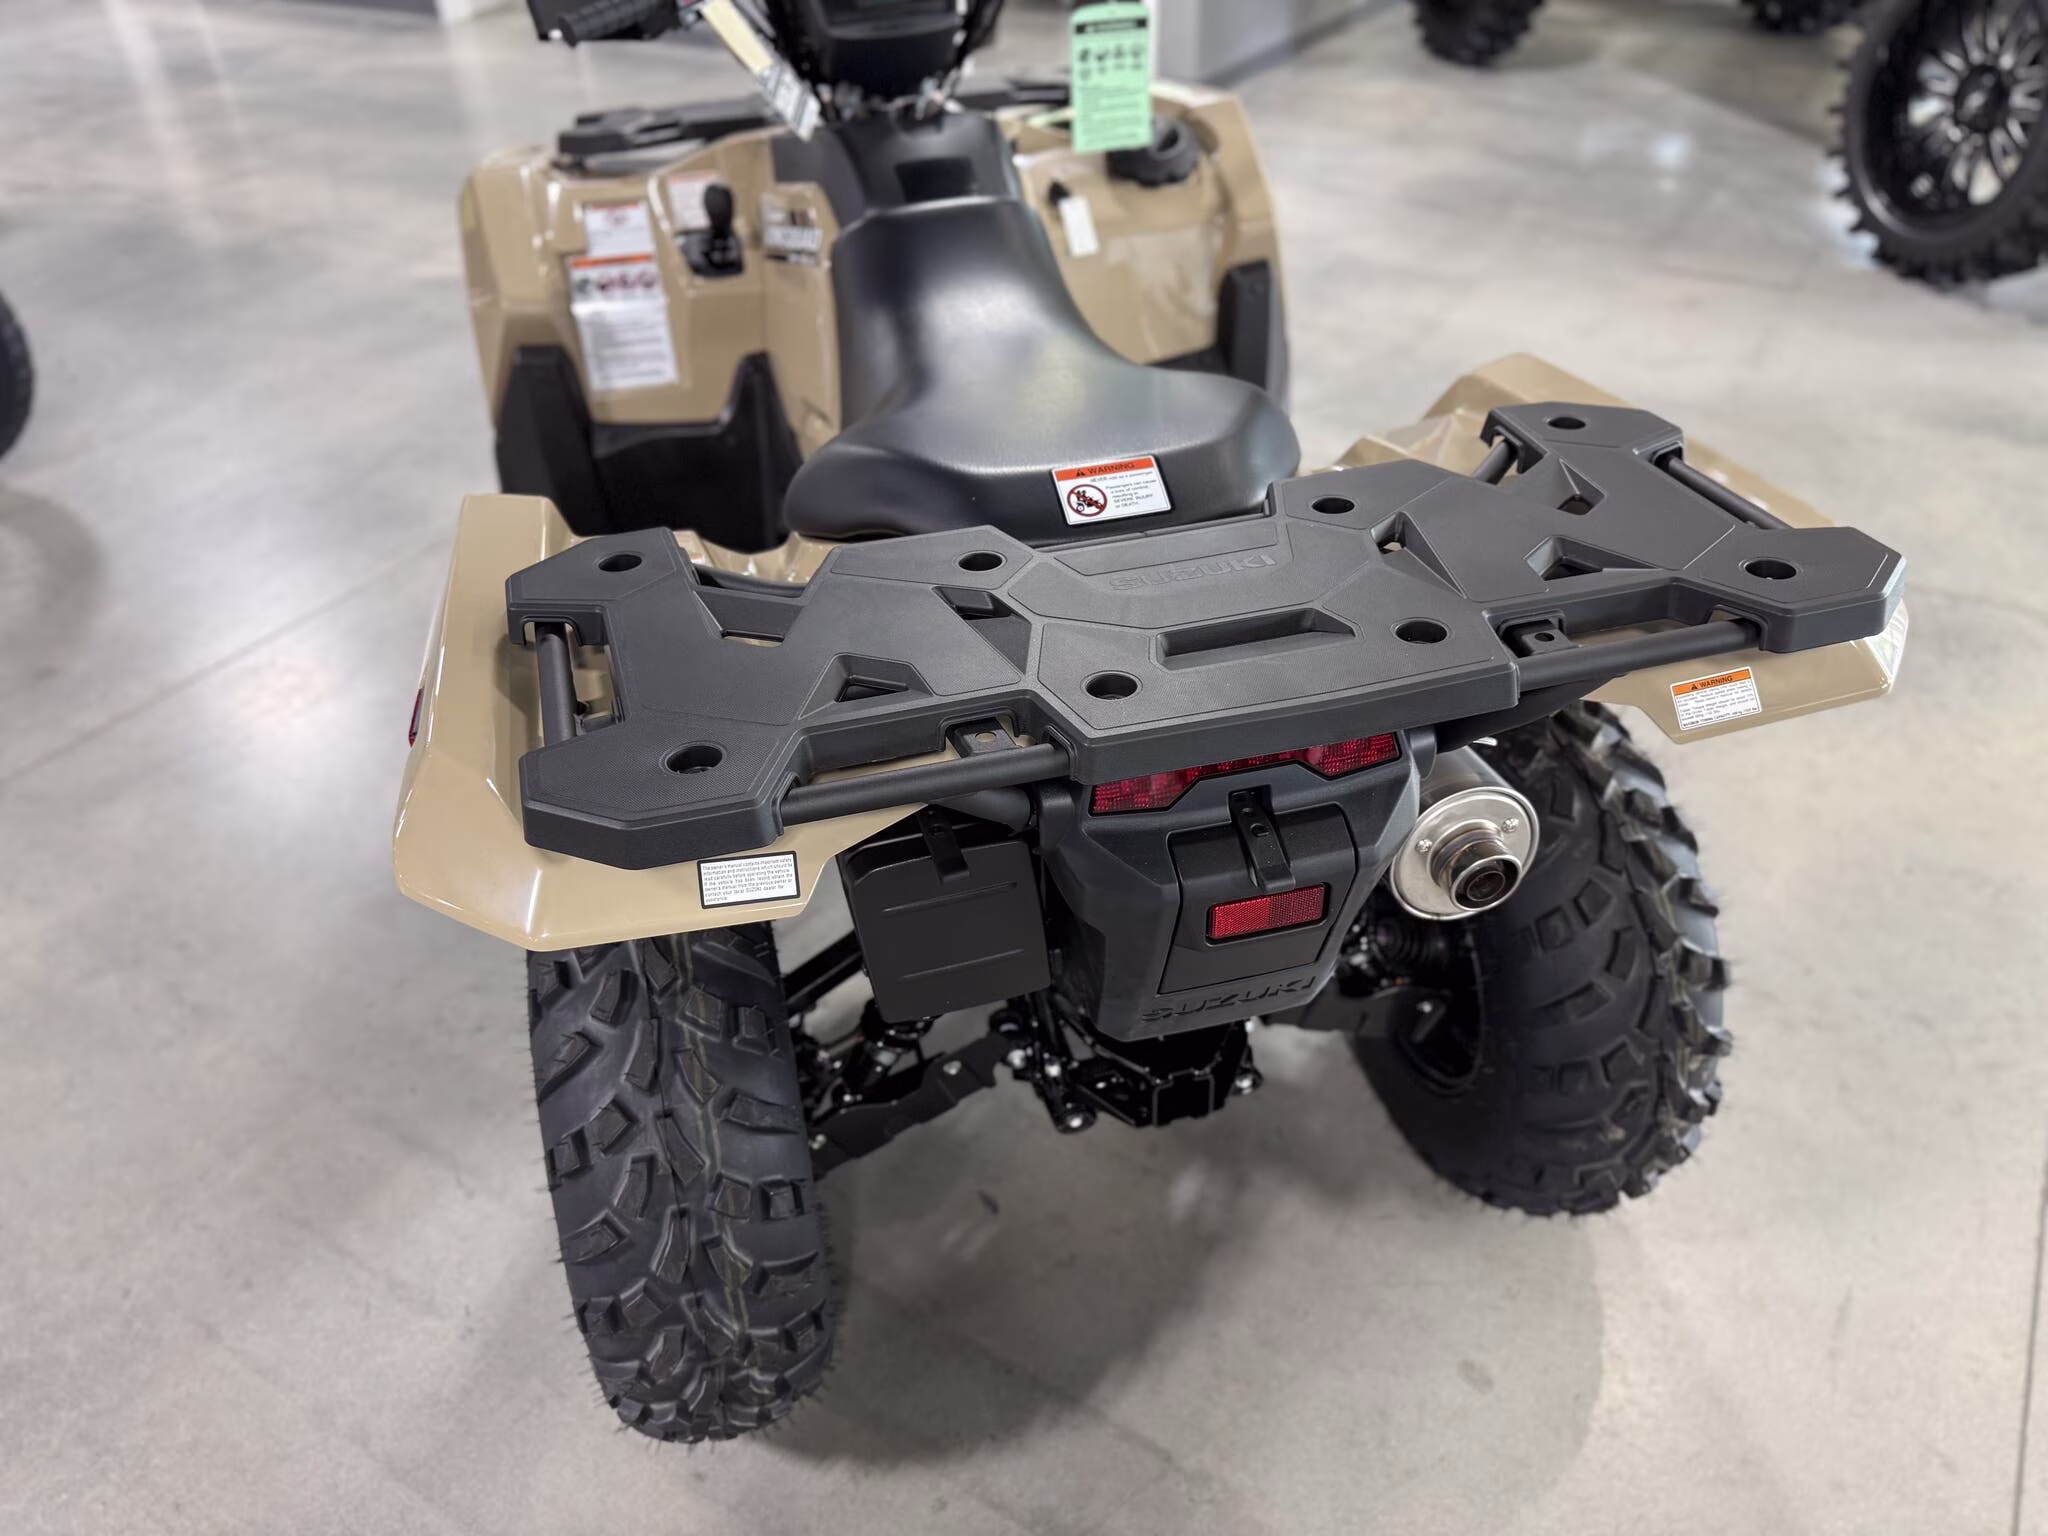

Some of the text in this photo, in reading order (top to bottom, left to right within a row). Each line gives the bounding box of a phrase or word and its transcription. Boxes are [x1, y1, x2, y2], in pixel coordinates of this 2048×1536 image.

[1088, 462, 1135, 474] WARNING
[1109, 554, 1277, 591] SUZUKI
[1699, 676, 1733, 688] WARNING
[1142, 976, 1316, 1022] SUZUKI
